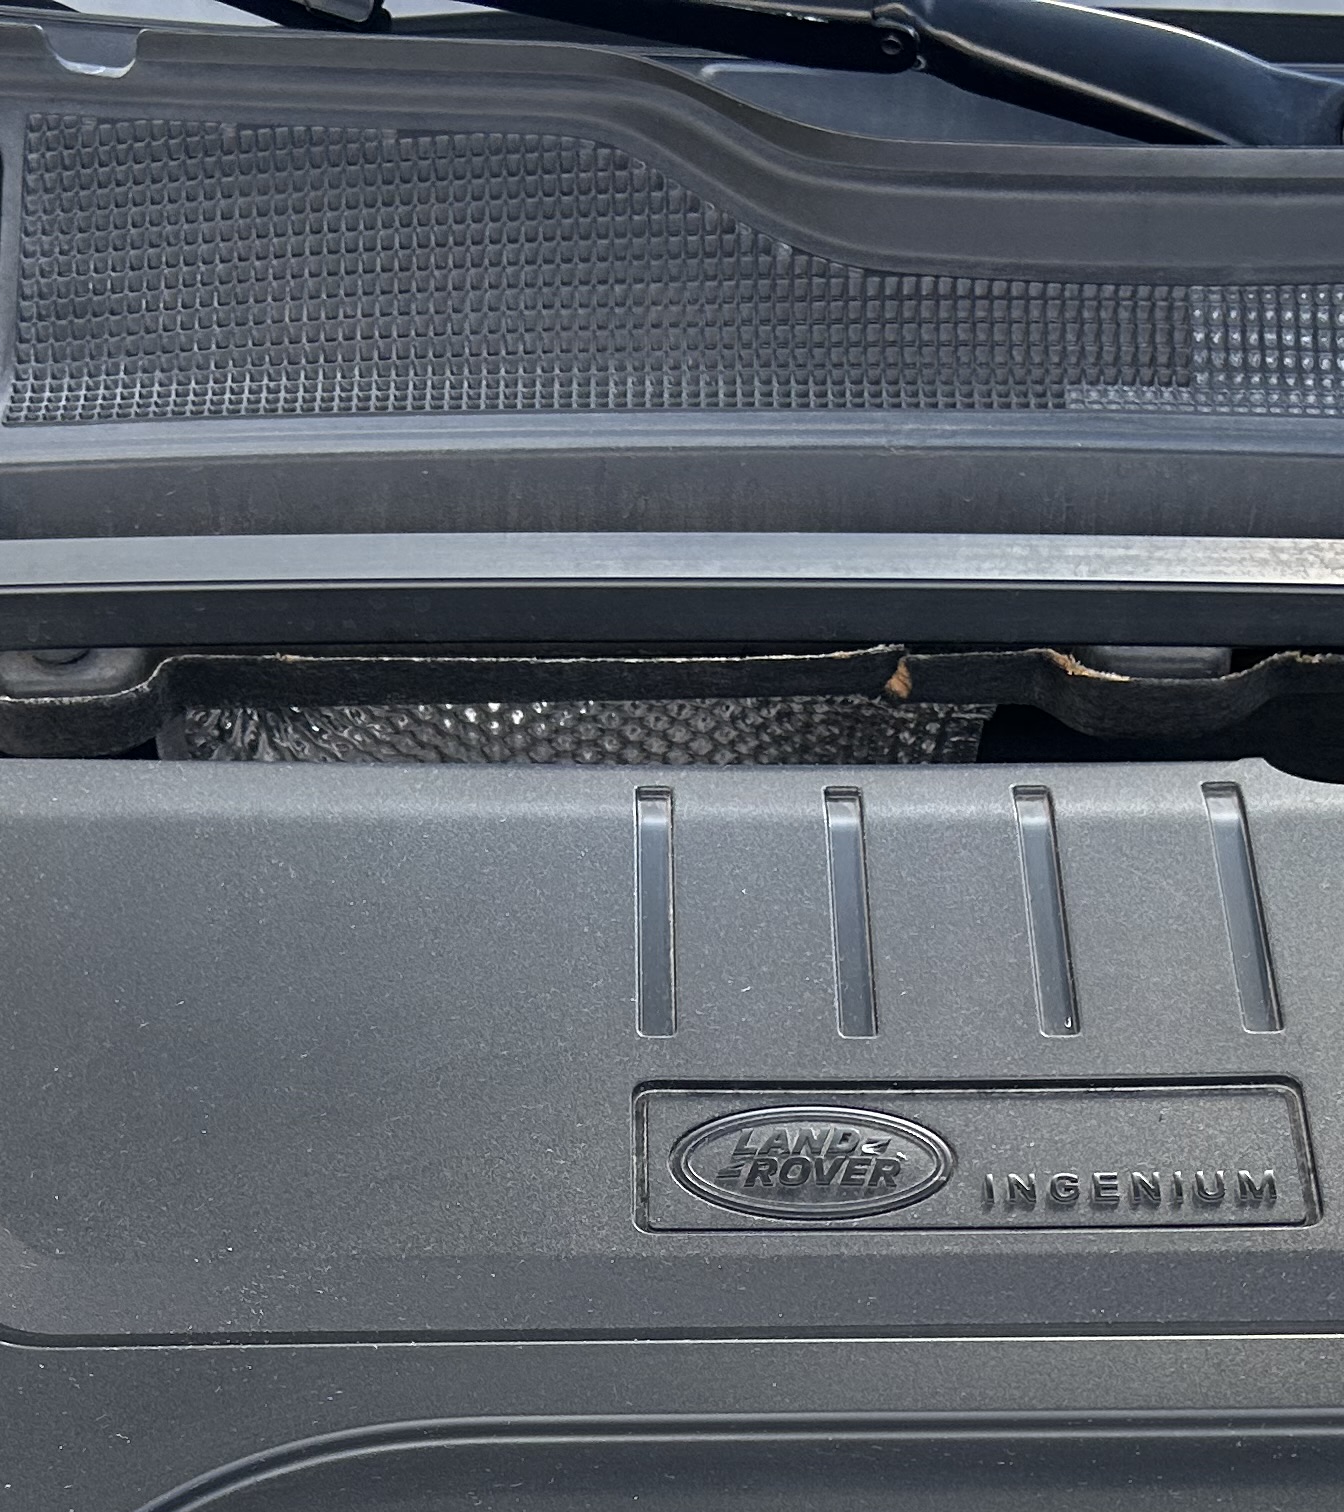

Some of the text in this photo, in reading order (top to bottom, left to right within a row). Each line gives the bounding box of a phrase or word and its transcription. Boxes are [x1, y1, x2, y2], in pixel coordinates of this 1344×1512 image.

[733, 1127, 861, 1156] LAND
[744, 1156, 901, 1188] ROVER
[984, 1169, 1278, 1205] INGENIUM
